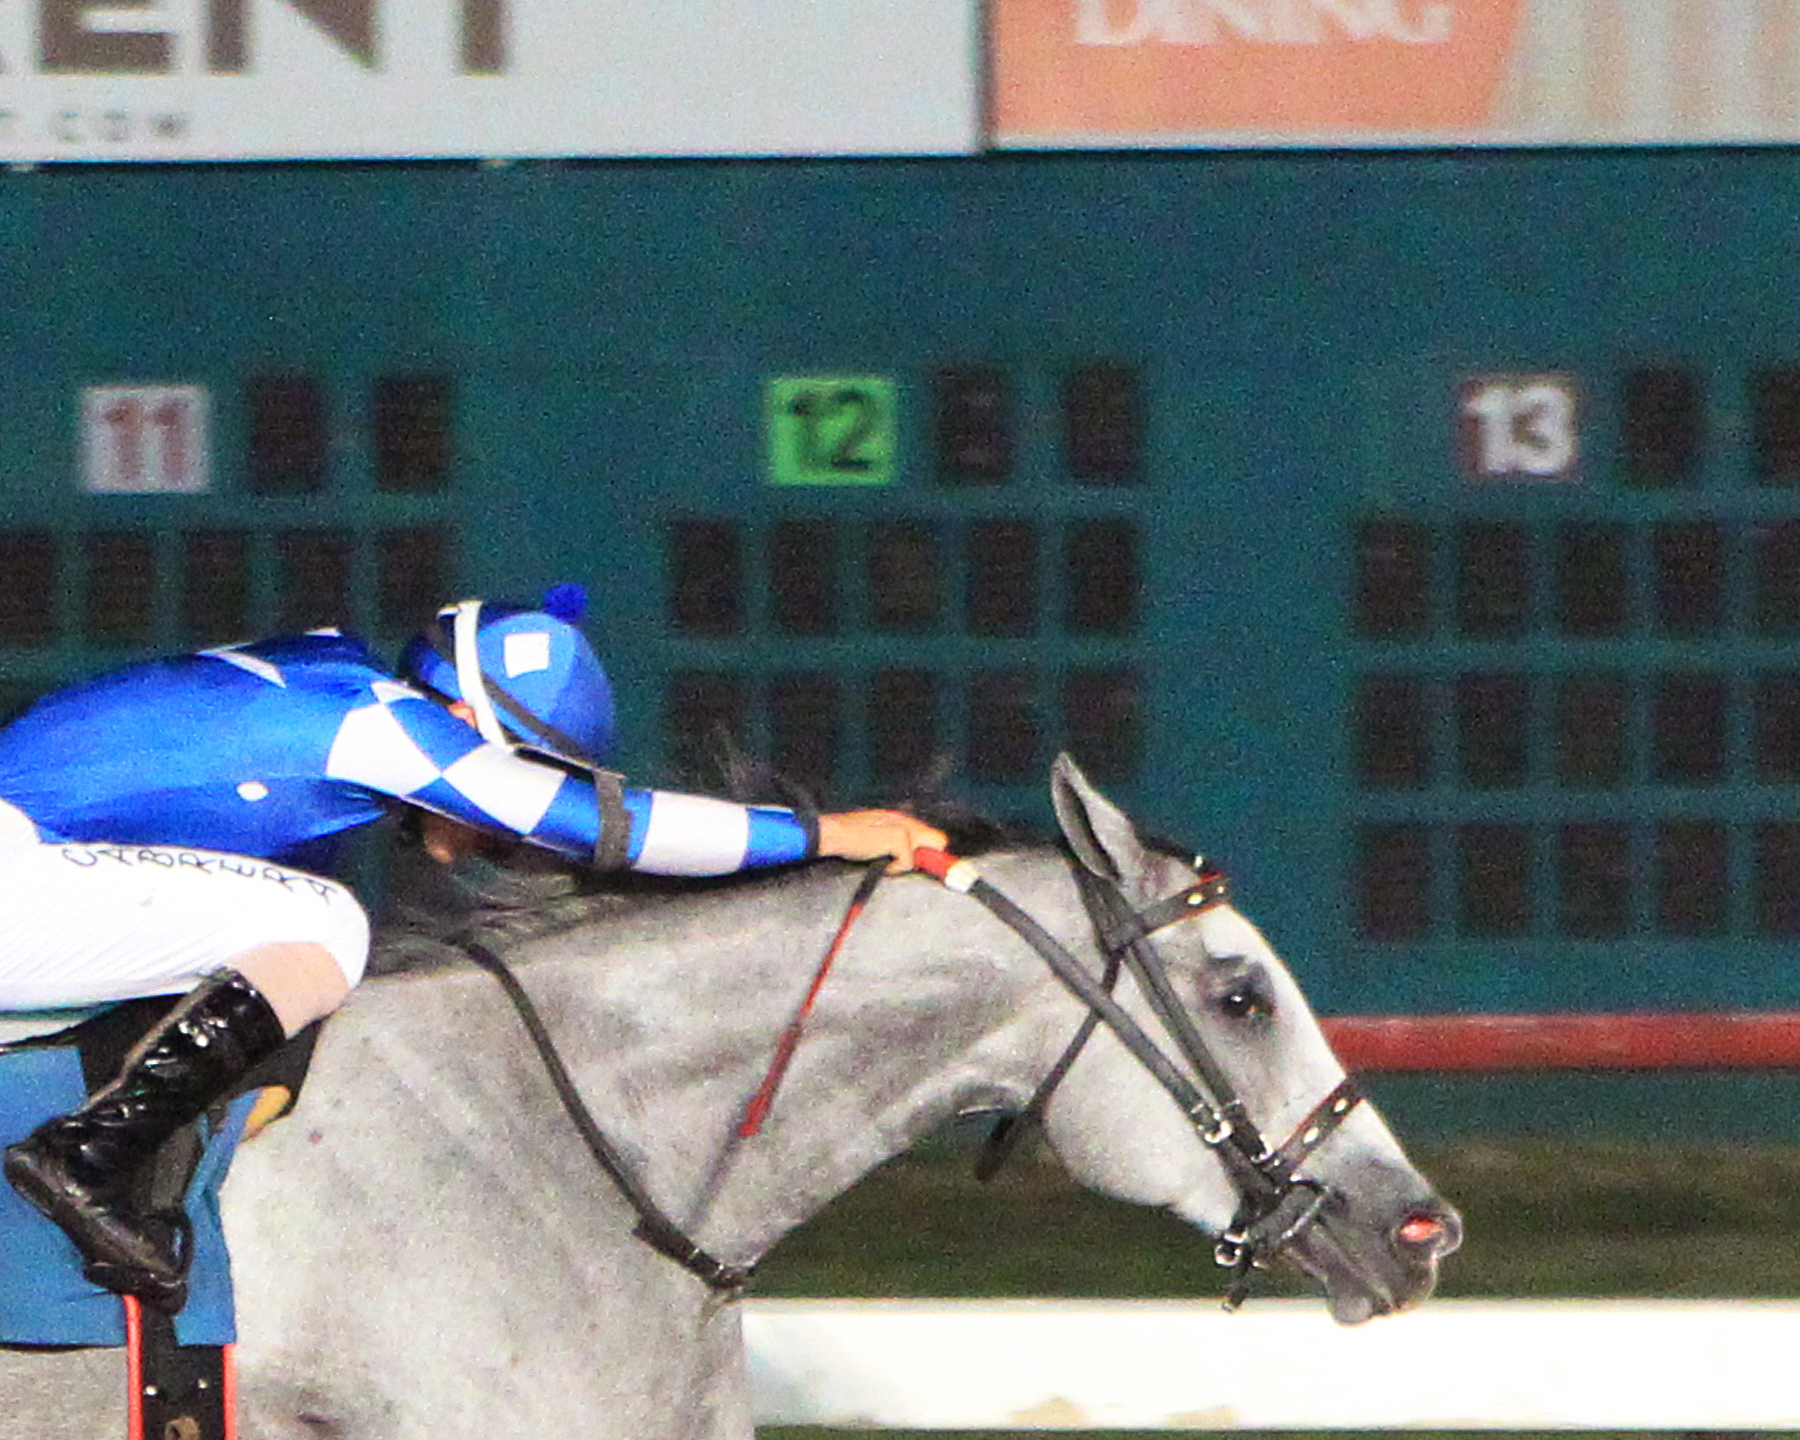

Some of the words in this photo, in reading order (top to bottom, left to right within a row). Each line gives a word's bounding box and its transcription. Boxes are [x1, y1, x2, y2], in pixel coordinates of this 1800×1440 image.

[103, 398, 187, 481] 11
[788, 389, 877, 471] 12
[1464, 384, 1571, 474] 13
[61, 846, 338, 905] CABRERA
